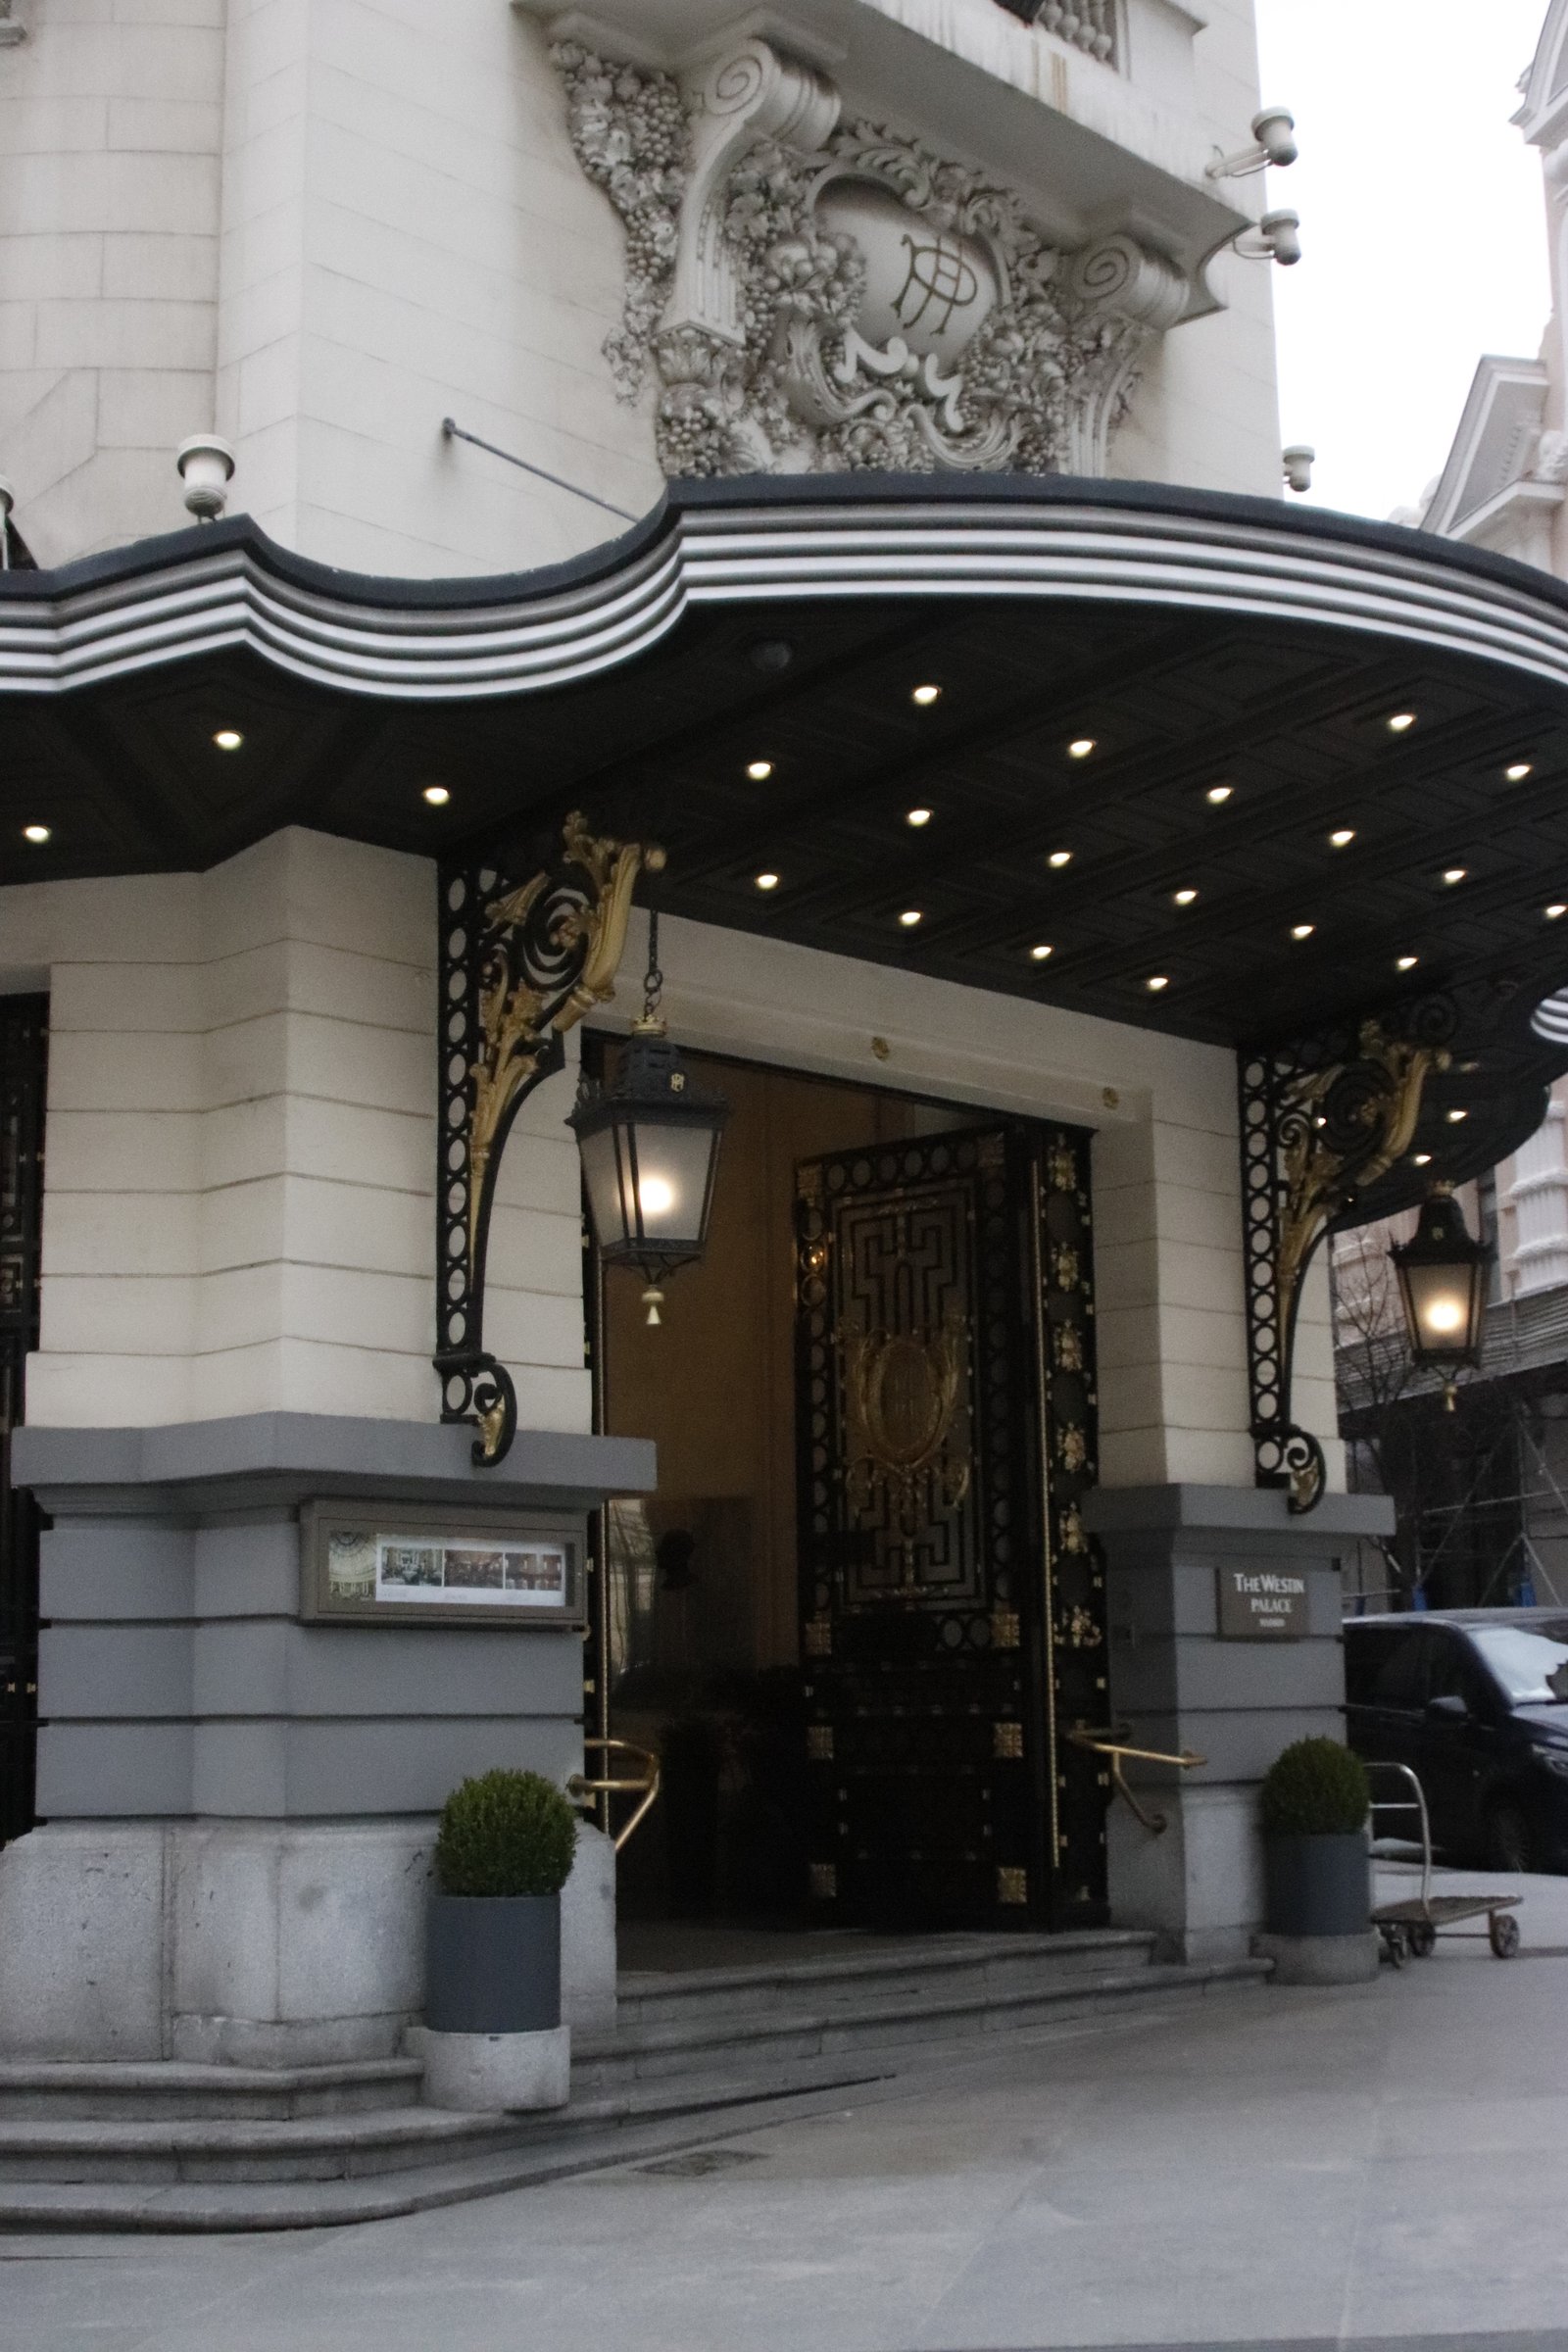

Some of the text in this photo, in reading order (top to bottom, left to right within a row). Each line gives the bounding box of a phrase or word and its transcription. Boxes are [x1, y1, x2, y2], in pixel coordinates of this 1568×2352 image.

[1233, 1573, 1304, 1593] THE WESTIN
[1250, 1598, 1292, 1613] PALACE
